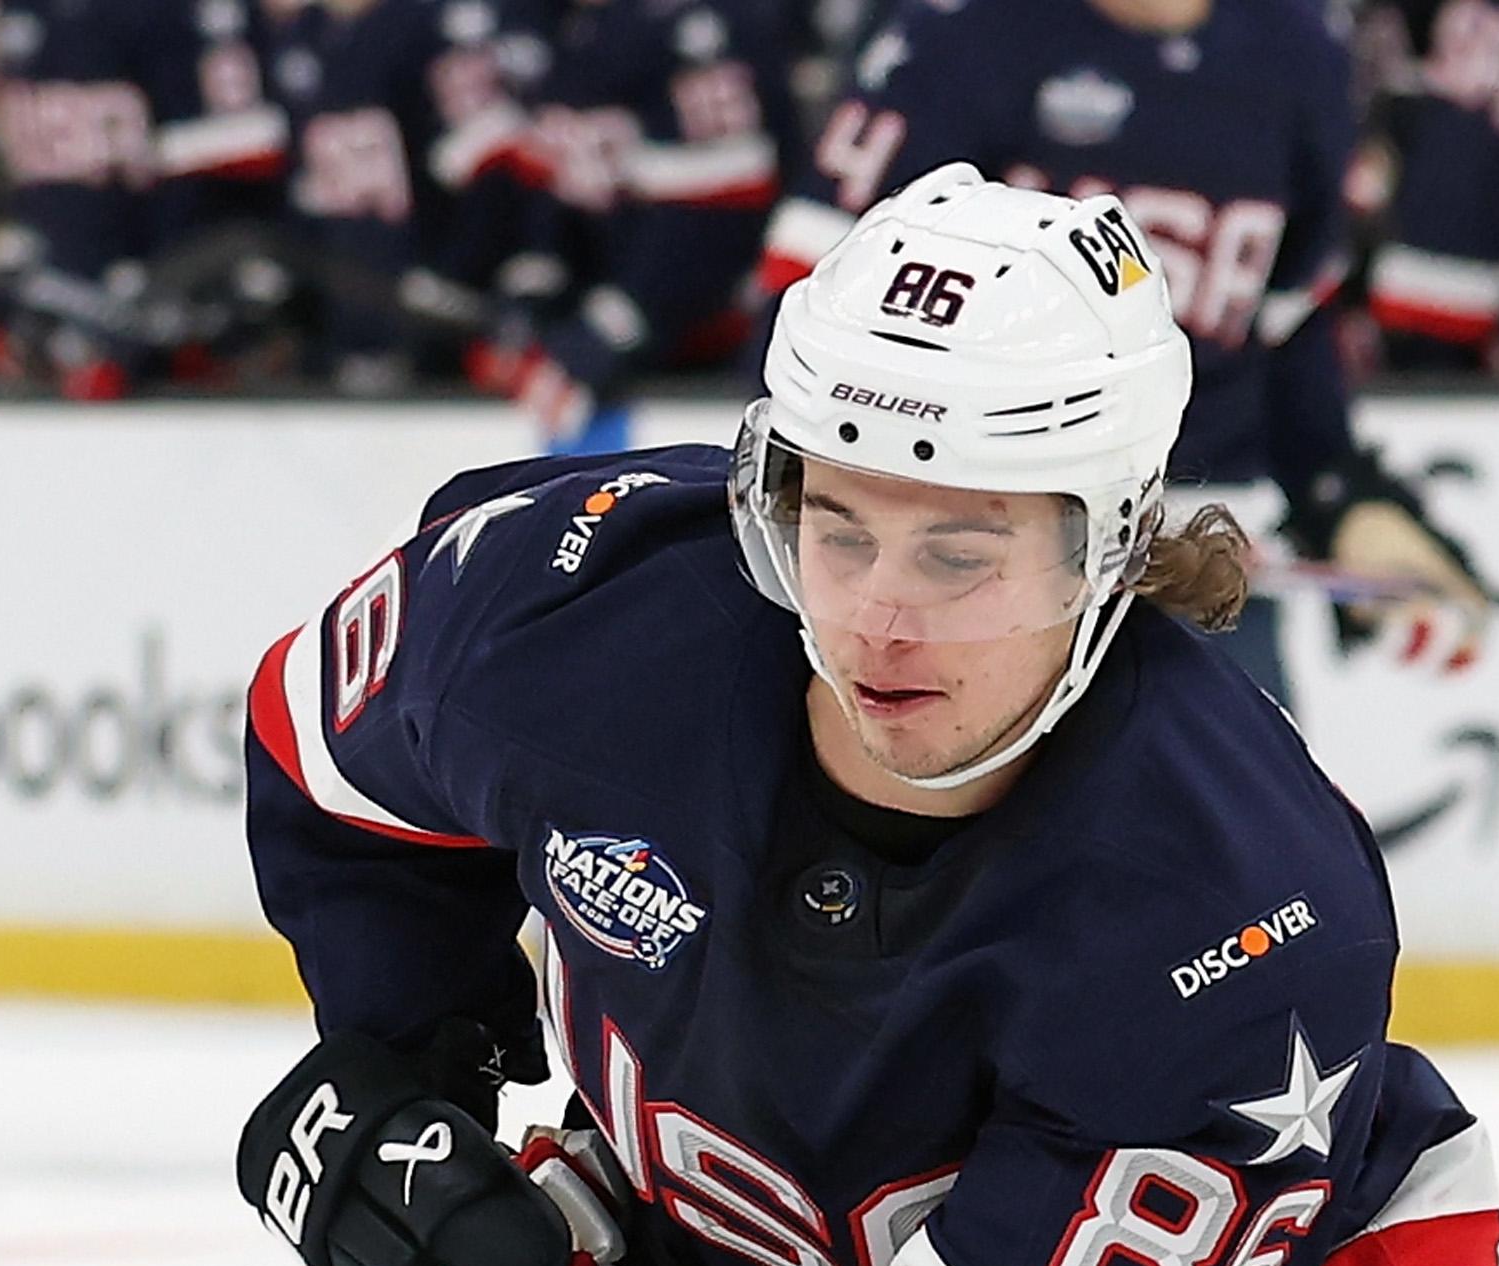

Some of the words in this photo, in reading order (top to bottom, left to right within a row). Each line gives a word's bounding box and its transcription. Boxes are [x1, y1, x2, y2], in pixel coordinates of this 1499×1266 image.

[879, 261, 976, 328] 86
[1069, 206, 1151, 297] CAT
[830, 382, 947, 423] BAUER
[333, 548, 405, 733] 6
[545, 829, 706, 934] NATIONS
[1171, 898, 1316, 999] DISCOVER
